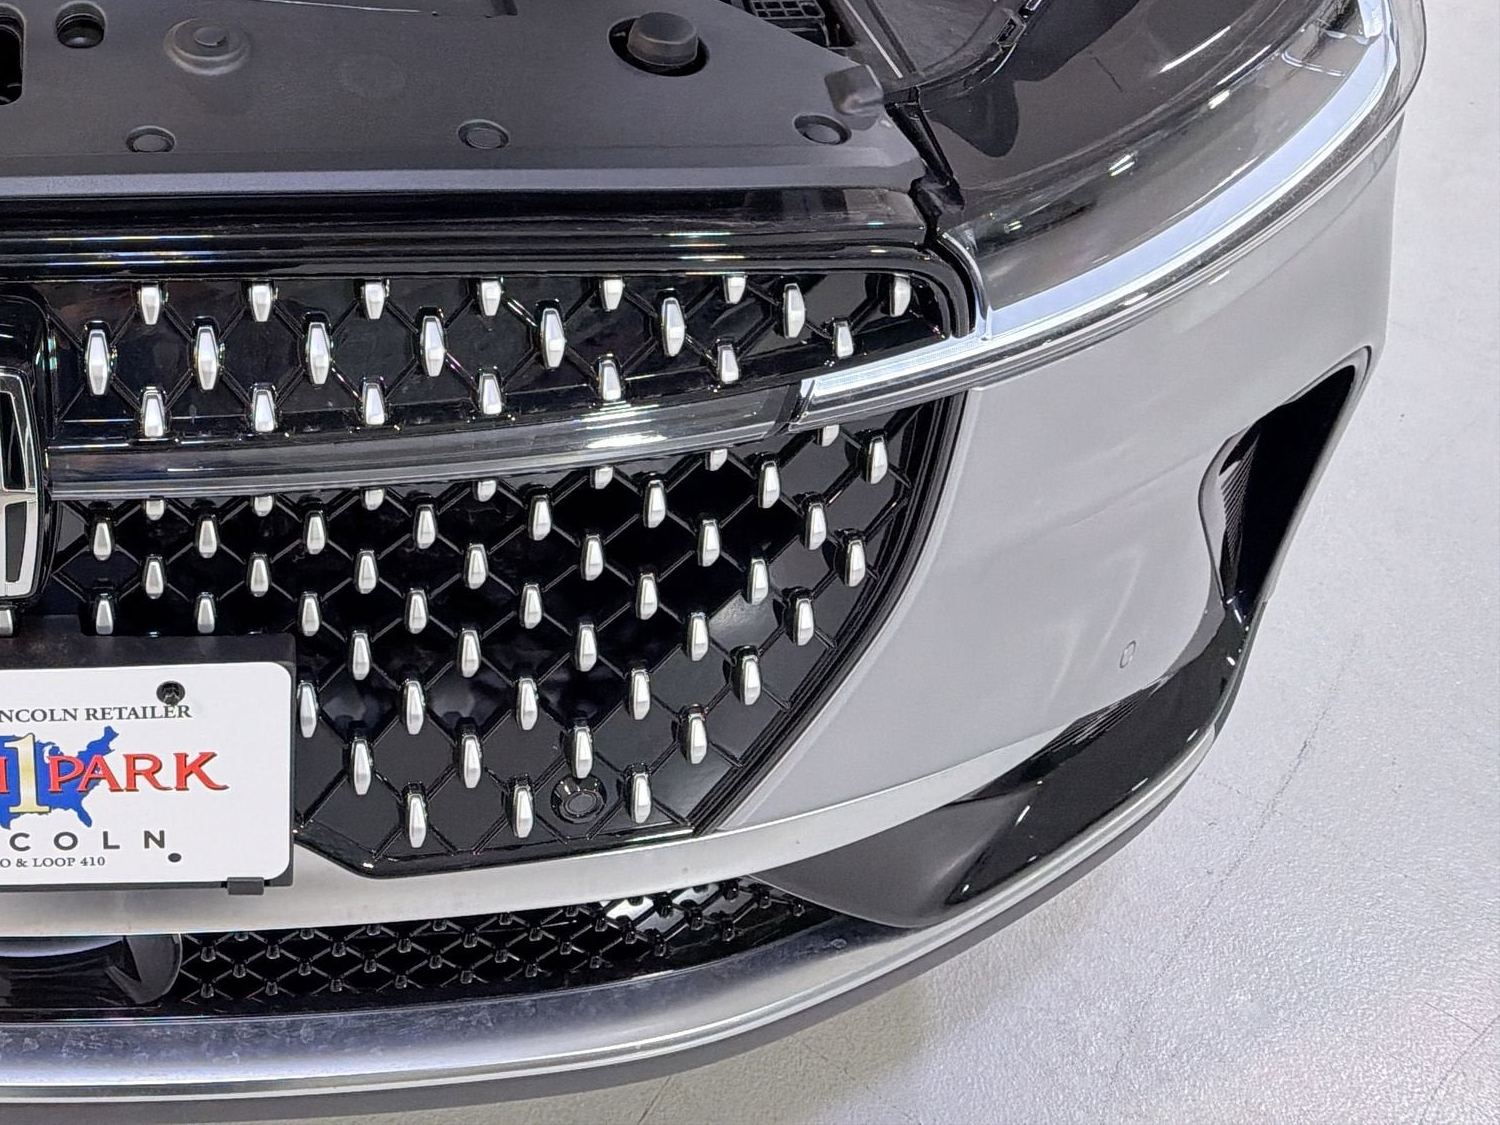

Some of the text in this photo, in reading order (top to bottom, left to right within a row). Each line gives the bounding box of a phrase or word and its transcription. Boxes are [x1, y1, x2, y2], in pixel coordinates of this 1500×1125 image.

[85, 704, 193, 721] RETAILER
[48, 751, 230, 793] PARK
[15, 857, 29, 869] &
[32, 856, 76, 868] LOOP
[80, 855, 106, 867] 410
